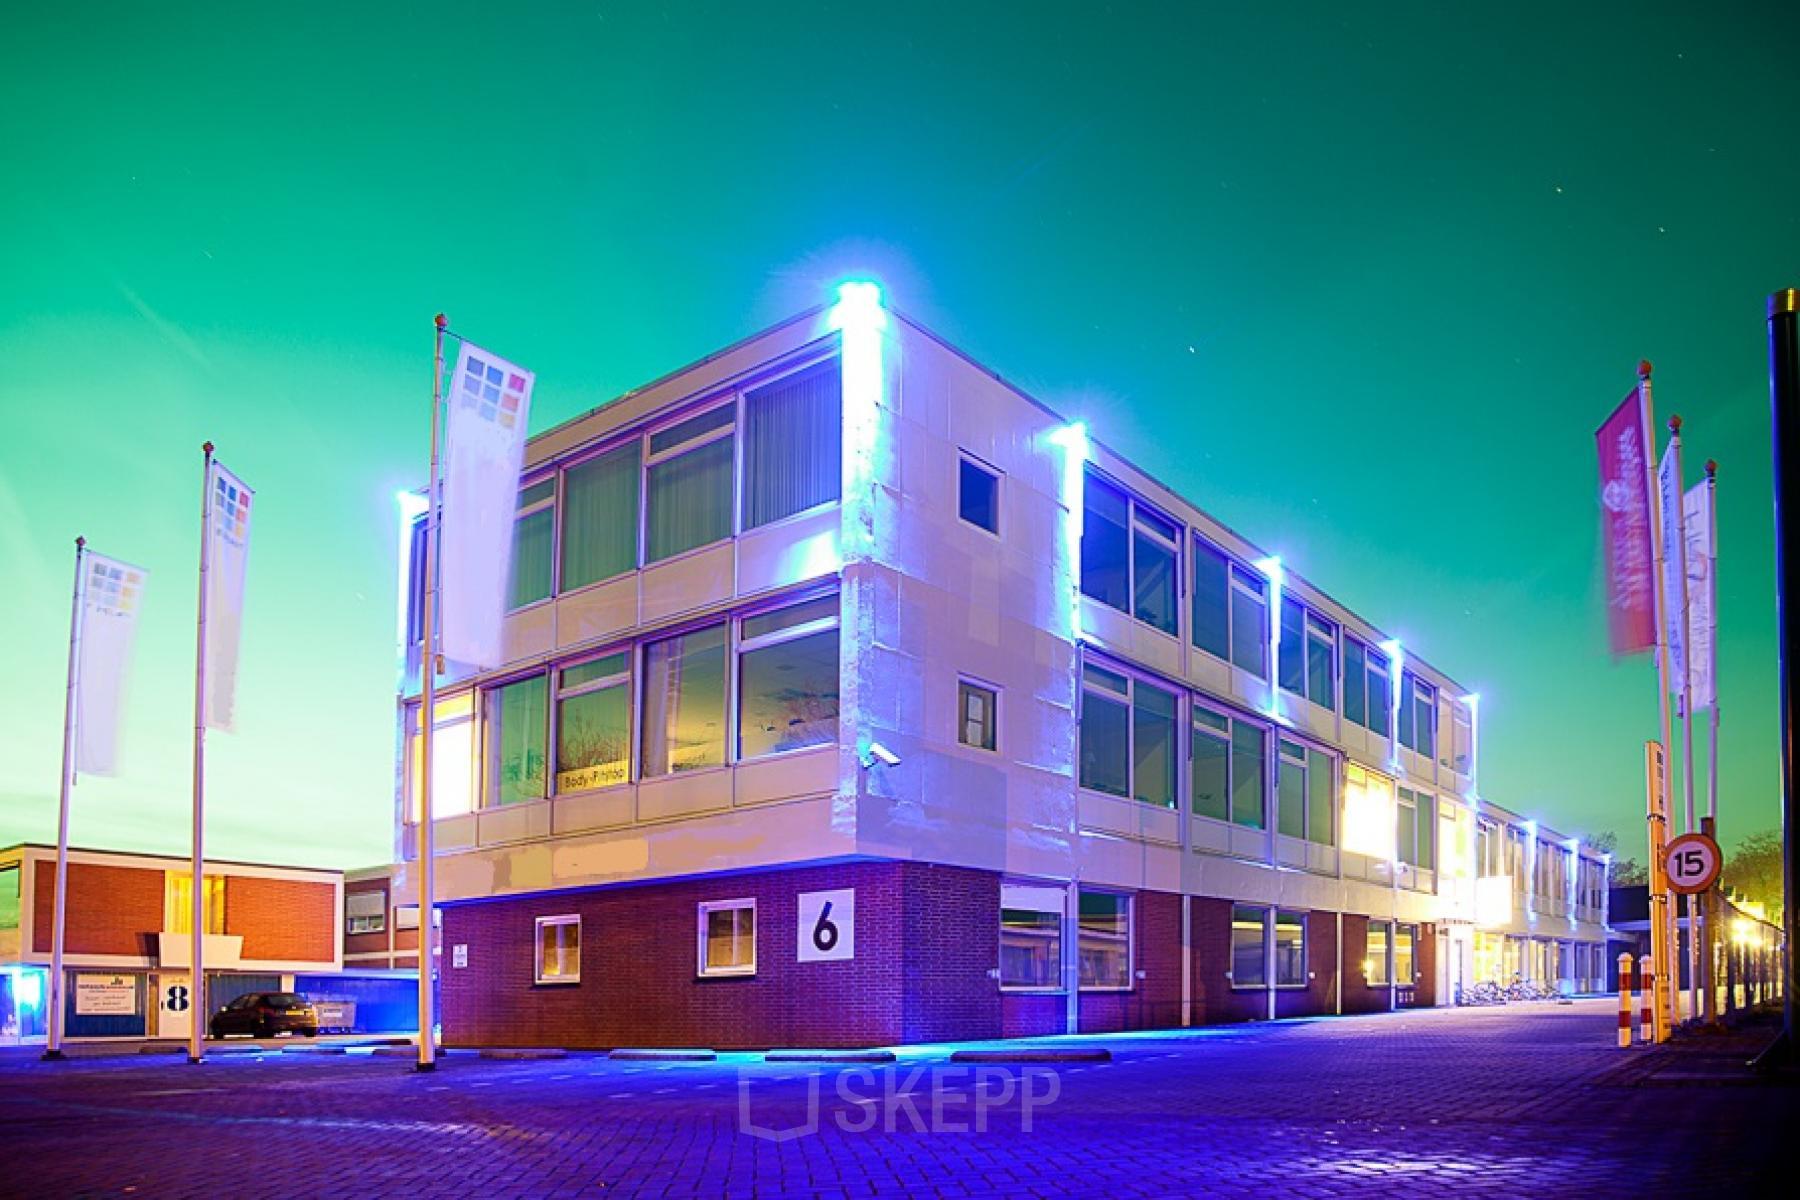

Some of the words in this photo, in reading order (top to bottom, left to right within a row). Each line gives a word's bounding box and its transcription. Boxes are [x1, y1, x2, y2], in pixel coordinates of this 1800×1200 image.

[1674, 850, 1704, 878] 15
[813, 901, 838, 951] 6
[167, 986, 190, 1011] 8
